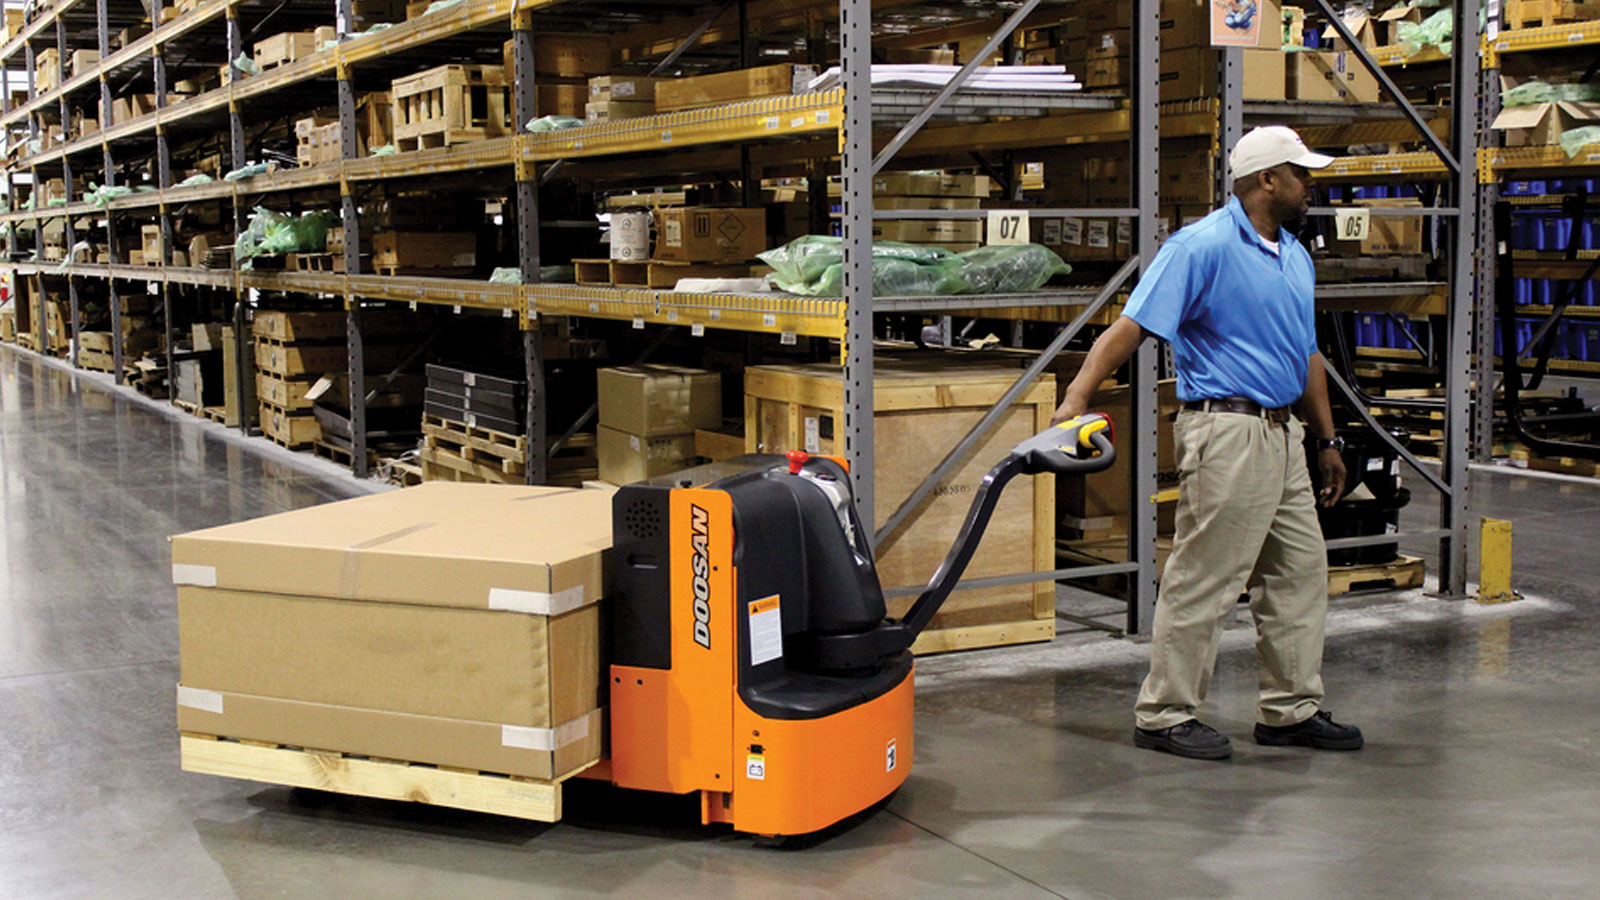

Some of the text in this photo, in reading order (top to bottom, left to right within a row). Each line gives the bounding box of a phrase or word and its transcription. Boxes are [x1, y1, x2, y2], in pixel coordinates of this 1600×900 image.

[1000, 216, 1020, 239] 07
[1346, 216, 1362, 237] 05
[691, 503, 711, 650] DOOSAN
